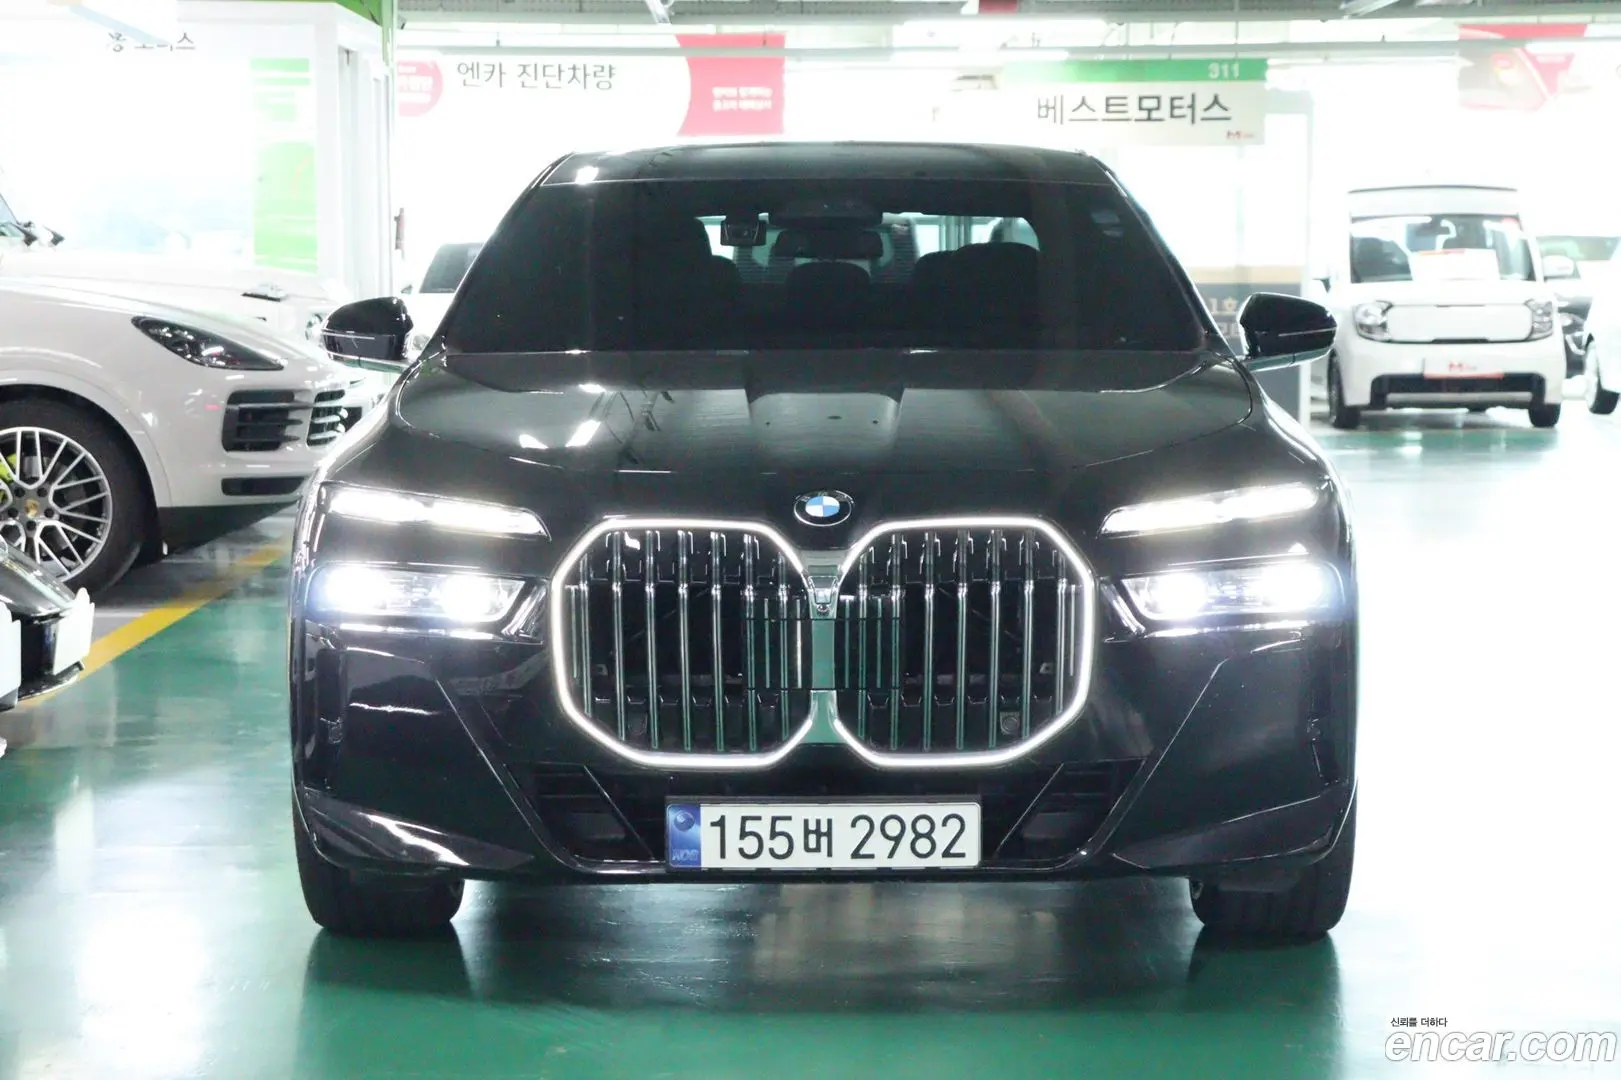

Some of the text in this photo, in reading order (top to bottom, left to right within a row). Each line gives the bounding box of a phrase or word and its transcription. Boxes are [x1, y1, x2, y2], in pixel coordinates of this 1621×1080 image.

[456, 61, 507, 88] 엔카
[517, 62, 616, 91] 진단차량
[1207, 62, 1240, 79] 311
[1037, 92, 1232, 125] 베스트모터스
[709, 812, 967, 860] 155버 2982
